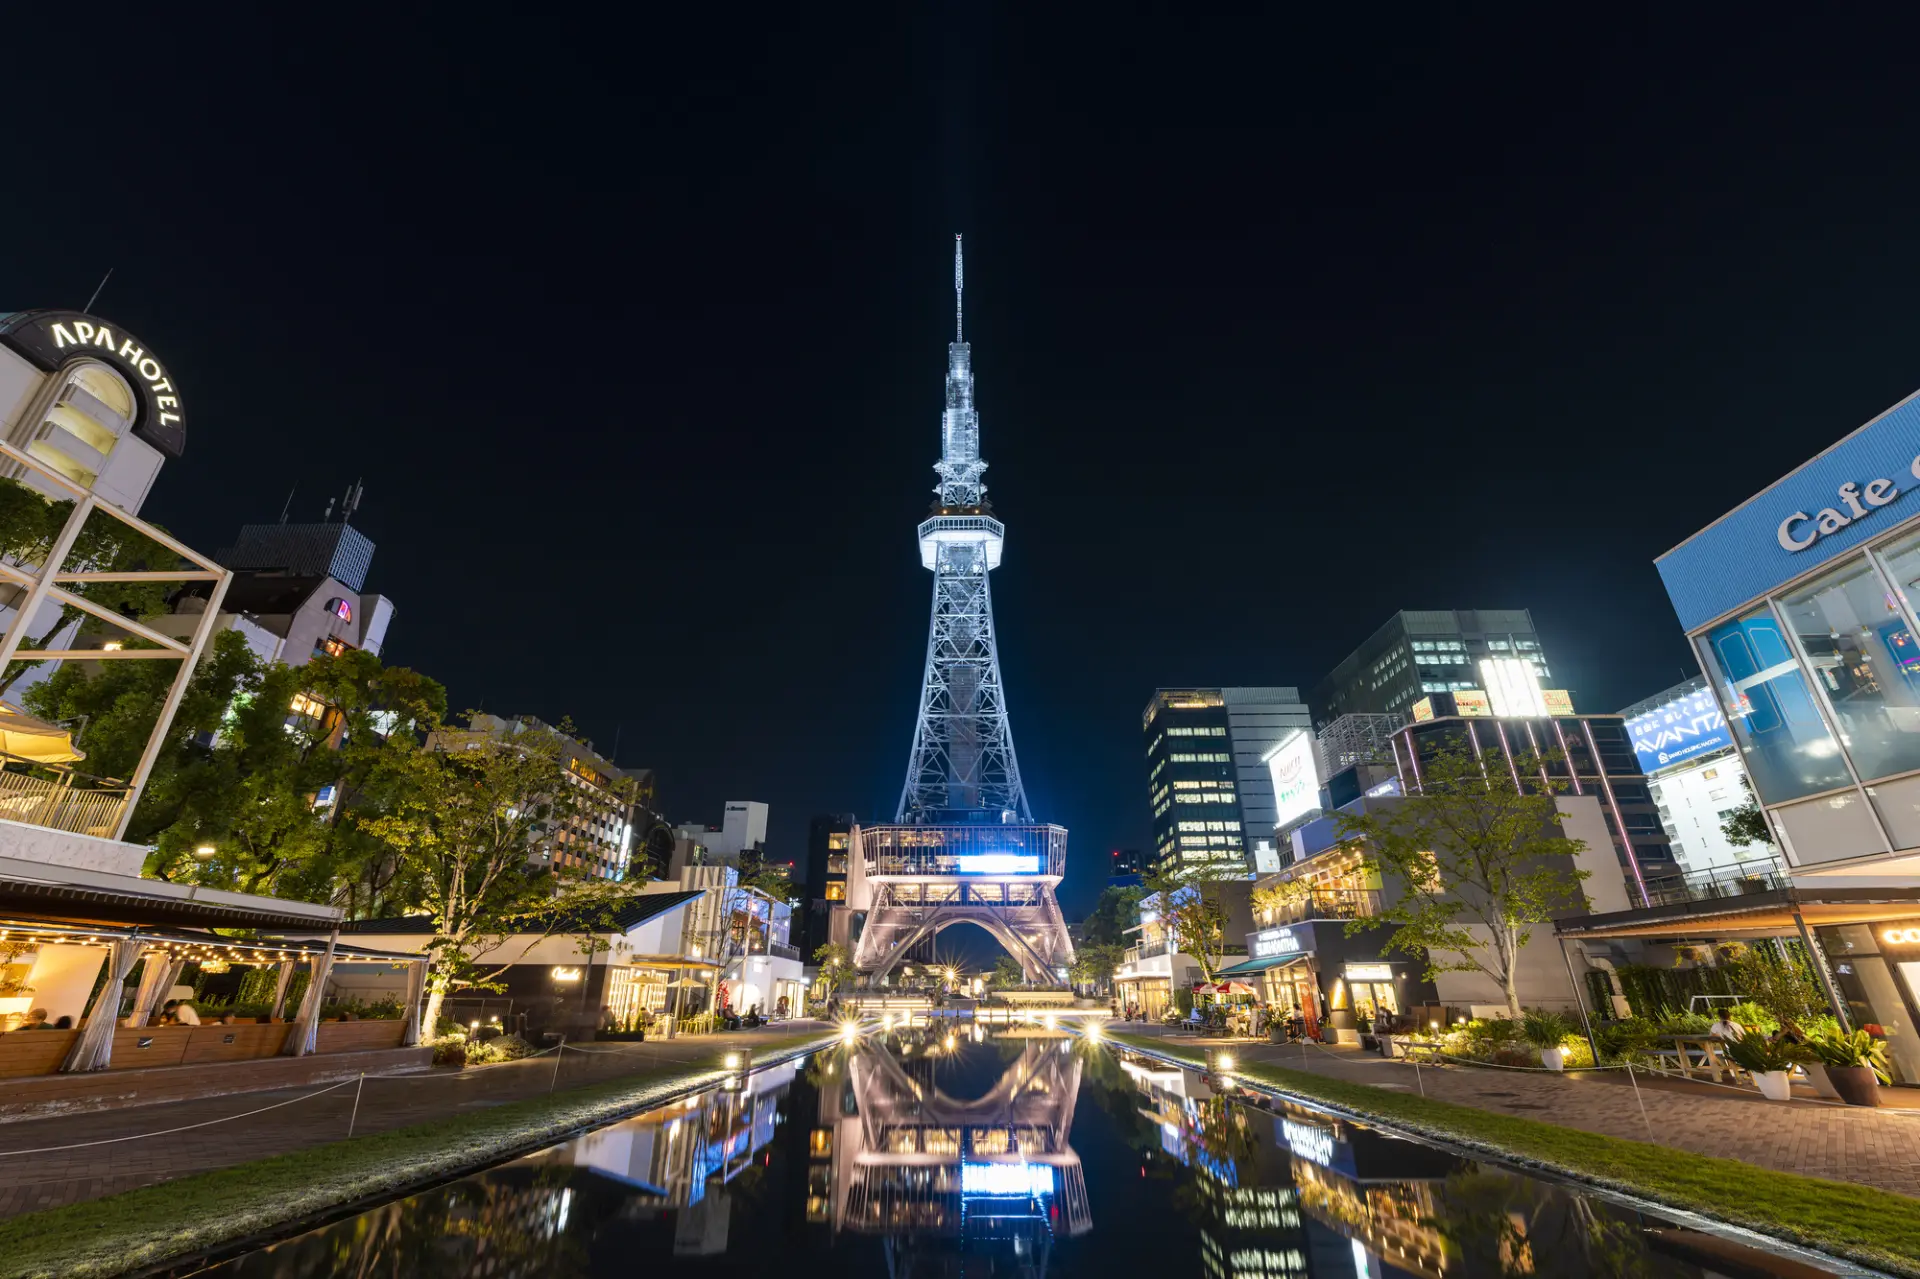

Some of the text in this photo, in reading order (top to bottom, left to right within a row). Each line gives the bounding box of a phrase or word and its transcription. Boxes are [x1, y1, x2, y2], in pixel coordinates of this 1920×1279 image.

[51, 321, 180, 426] APA HOTEL
[1777, 478, 1898, 551] Cafe
